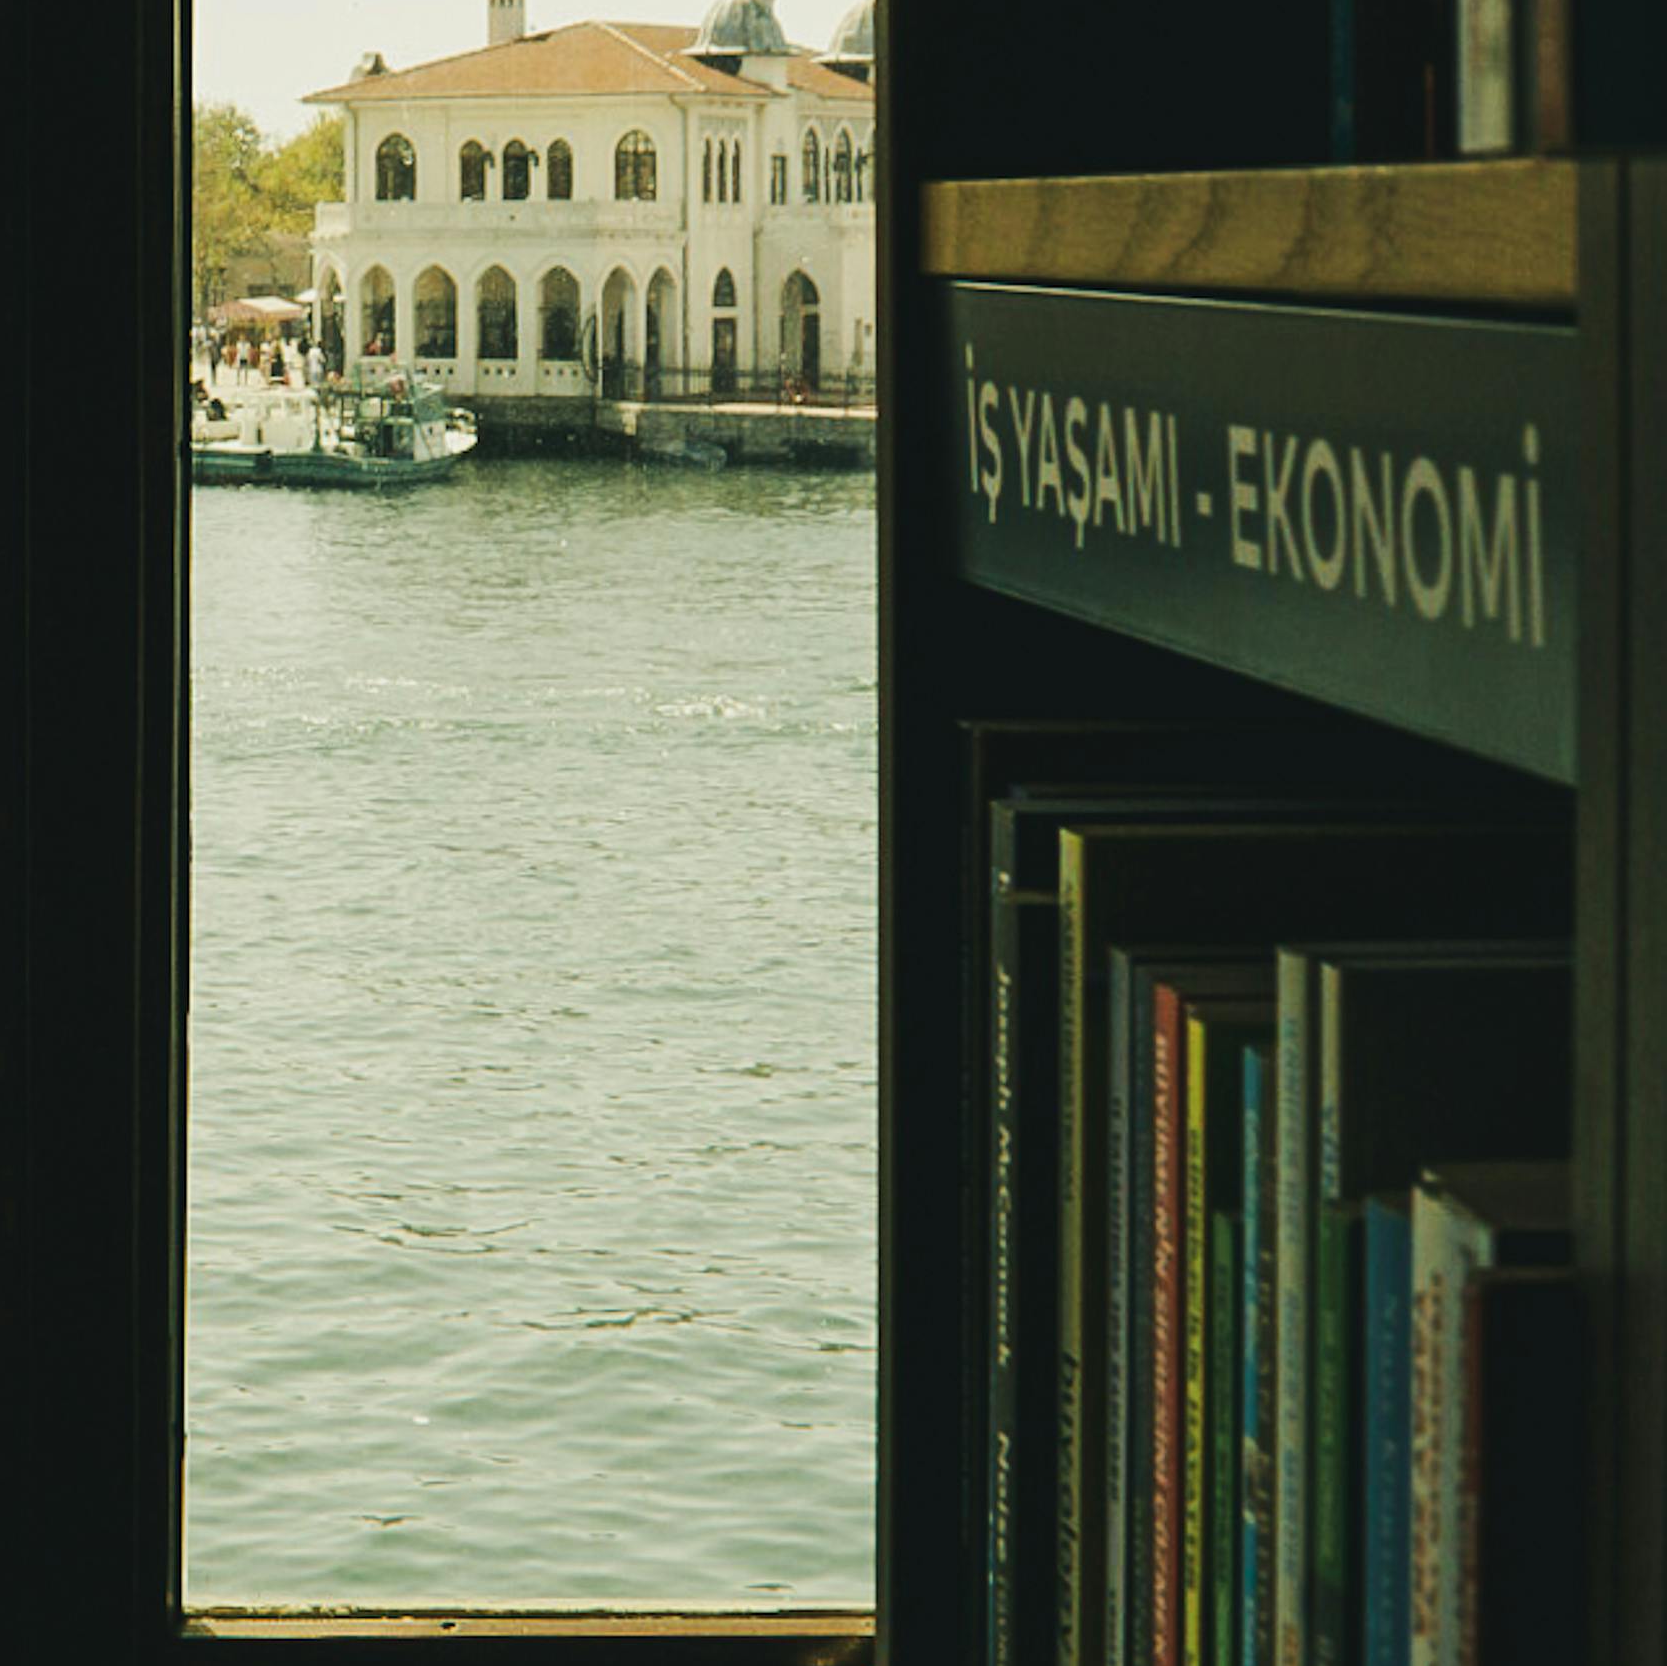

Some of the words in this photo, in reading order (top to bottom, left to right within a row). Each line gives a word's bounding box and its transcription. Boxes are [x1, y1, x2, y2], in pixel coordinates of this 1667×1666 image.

[965, 342, 1004, 524] İŞ
[1008, 385, 1182, 549] YAŞAMI
[1196, 491, 1214, 519] -
[1228, 422, 1546, 649] EKONOMİ
